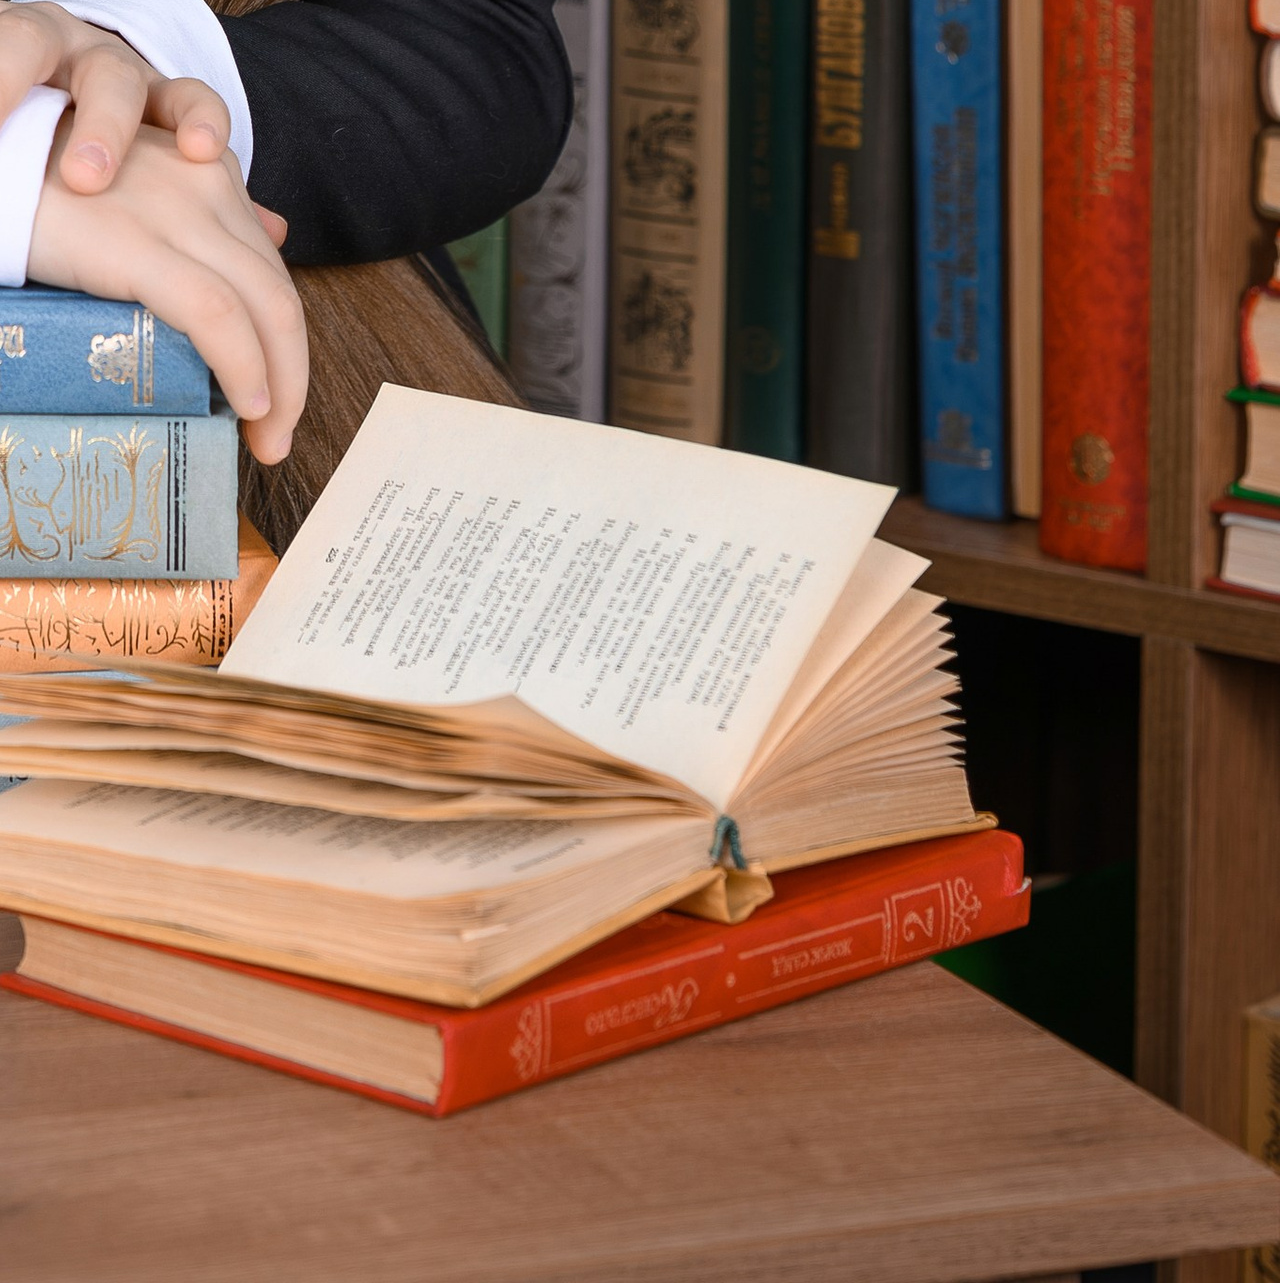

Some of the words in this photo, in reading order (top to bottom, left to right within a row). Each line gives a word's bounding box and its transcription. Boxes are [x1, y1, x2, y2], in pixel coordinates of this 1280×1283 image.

[400, 506, 417, 522] Да
[325, 547, 340, 563] 258
[341, 570, 354, 585] ли
[391, 565, 407, 581] он,
[365, 578, 374, 586] и
[320, 590, 330, 598] к
[304, 628, 319, 646] он,
[902, 905, 935, 943] 2
[584, 977, 699, 1037] Консуэло
